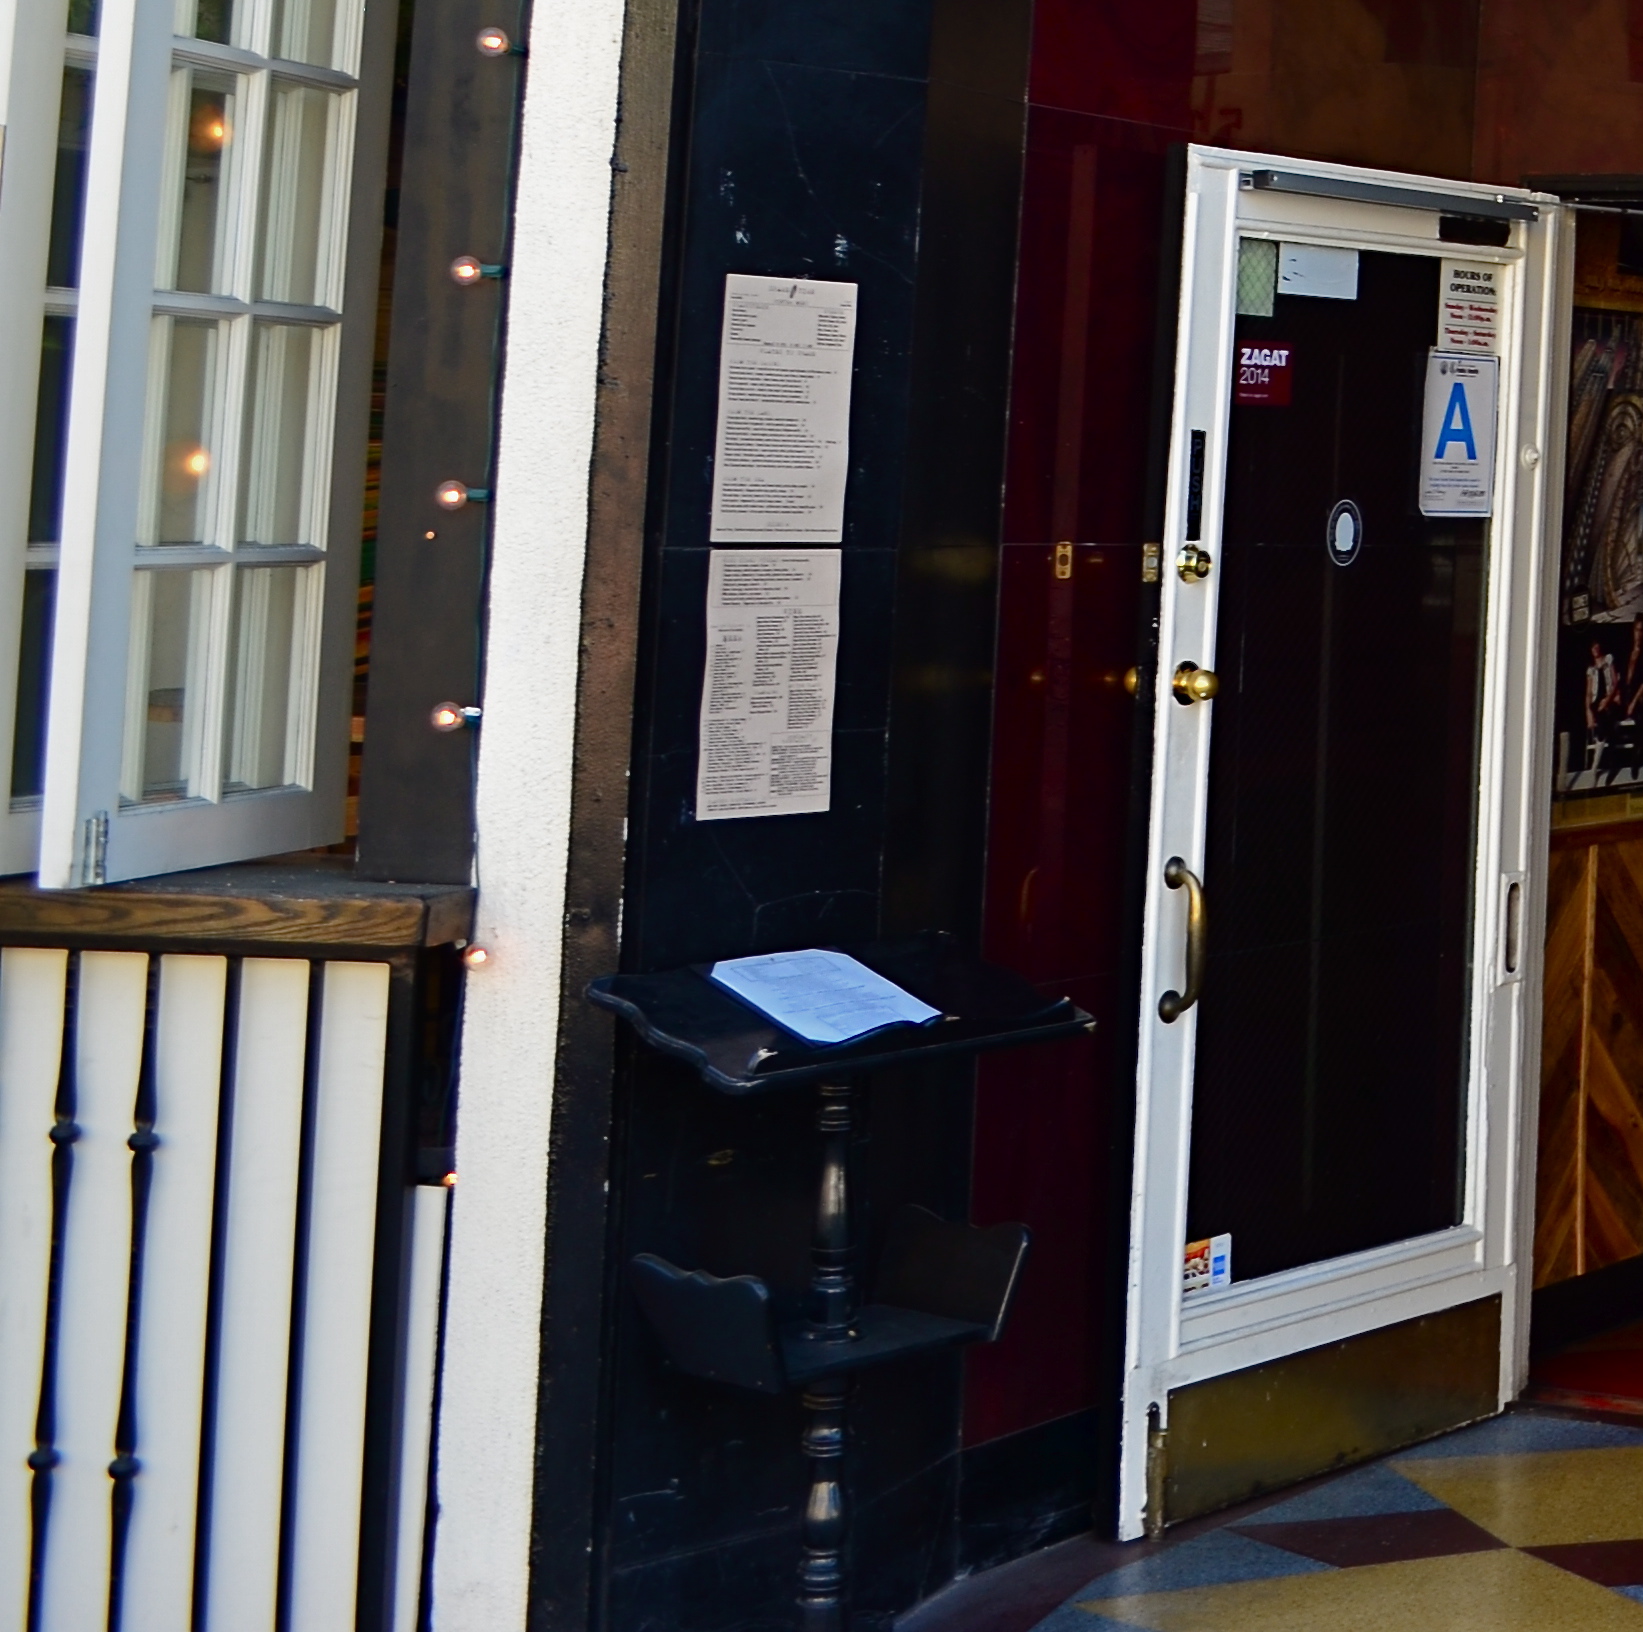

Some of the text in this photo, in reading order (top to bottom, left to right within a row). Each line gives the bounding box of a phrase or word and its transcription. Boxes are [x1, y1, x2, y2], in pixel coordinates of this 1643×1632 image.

[1240, 347, 1290, 367] ZAGAT
[1239, 366, 1270, 384] 2014
[1433, 381, 1478, 461] A
